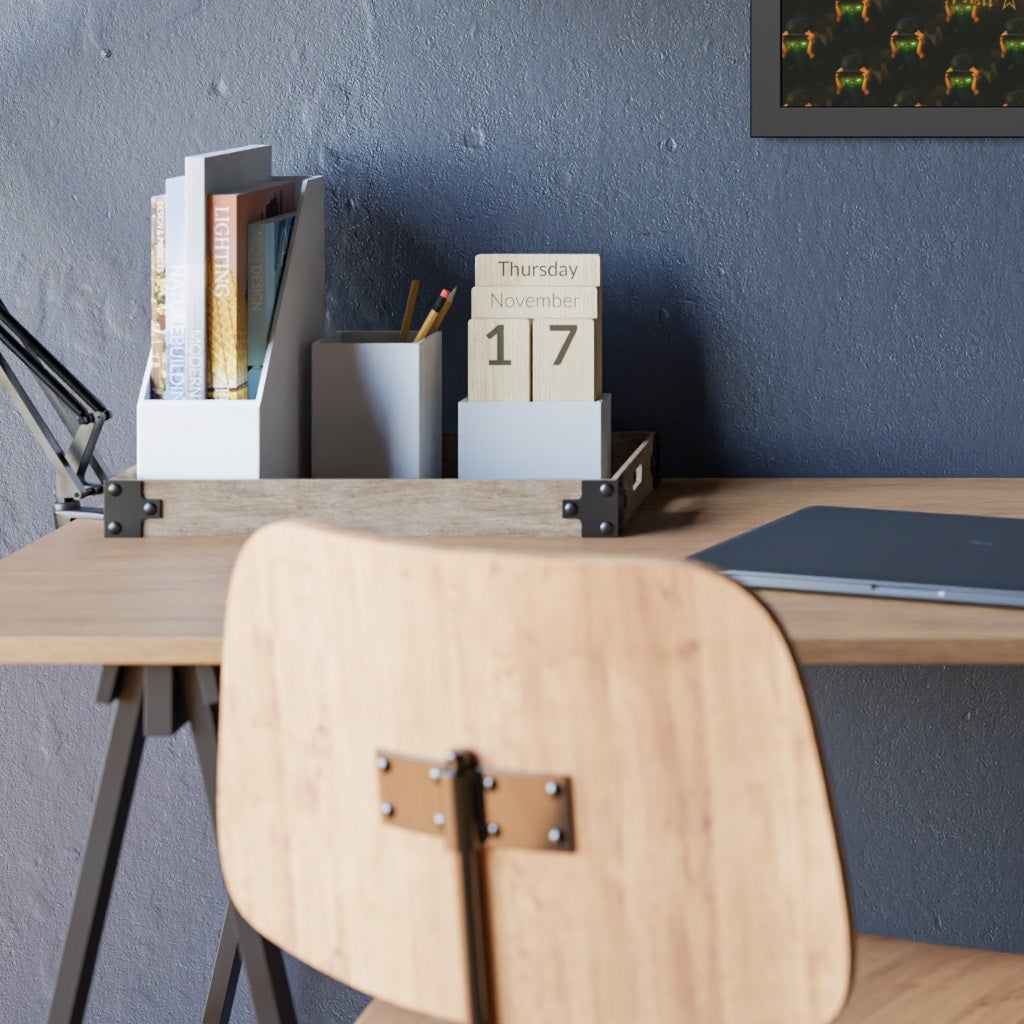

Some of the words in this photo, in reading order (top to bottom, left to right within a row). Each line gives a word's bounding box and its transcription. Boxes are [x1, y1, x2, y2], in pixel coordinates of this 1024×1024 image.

[213, 206, 230, 298] LIGHTING
[498, 260, 579, 280] Thursday
[252, 265, 264, 312] DESIGN
[490, 292, 581, 309] November
[188, 329, 202, 398] MODERN
